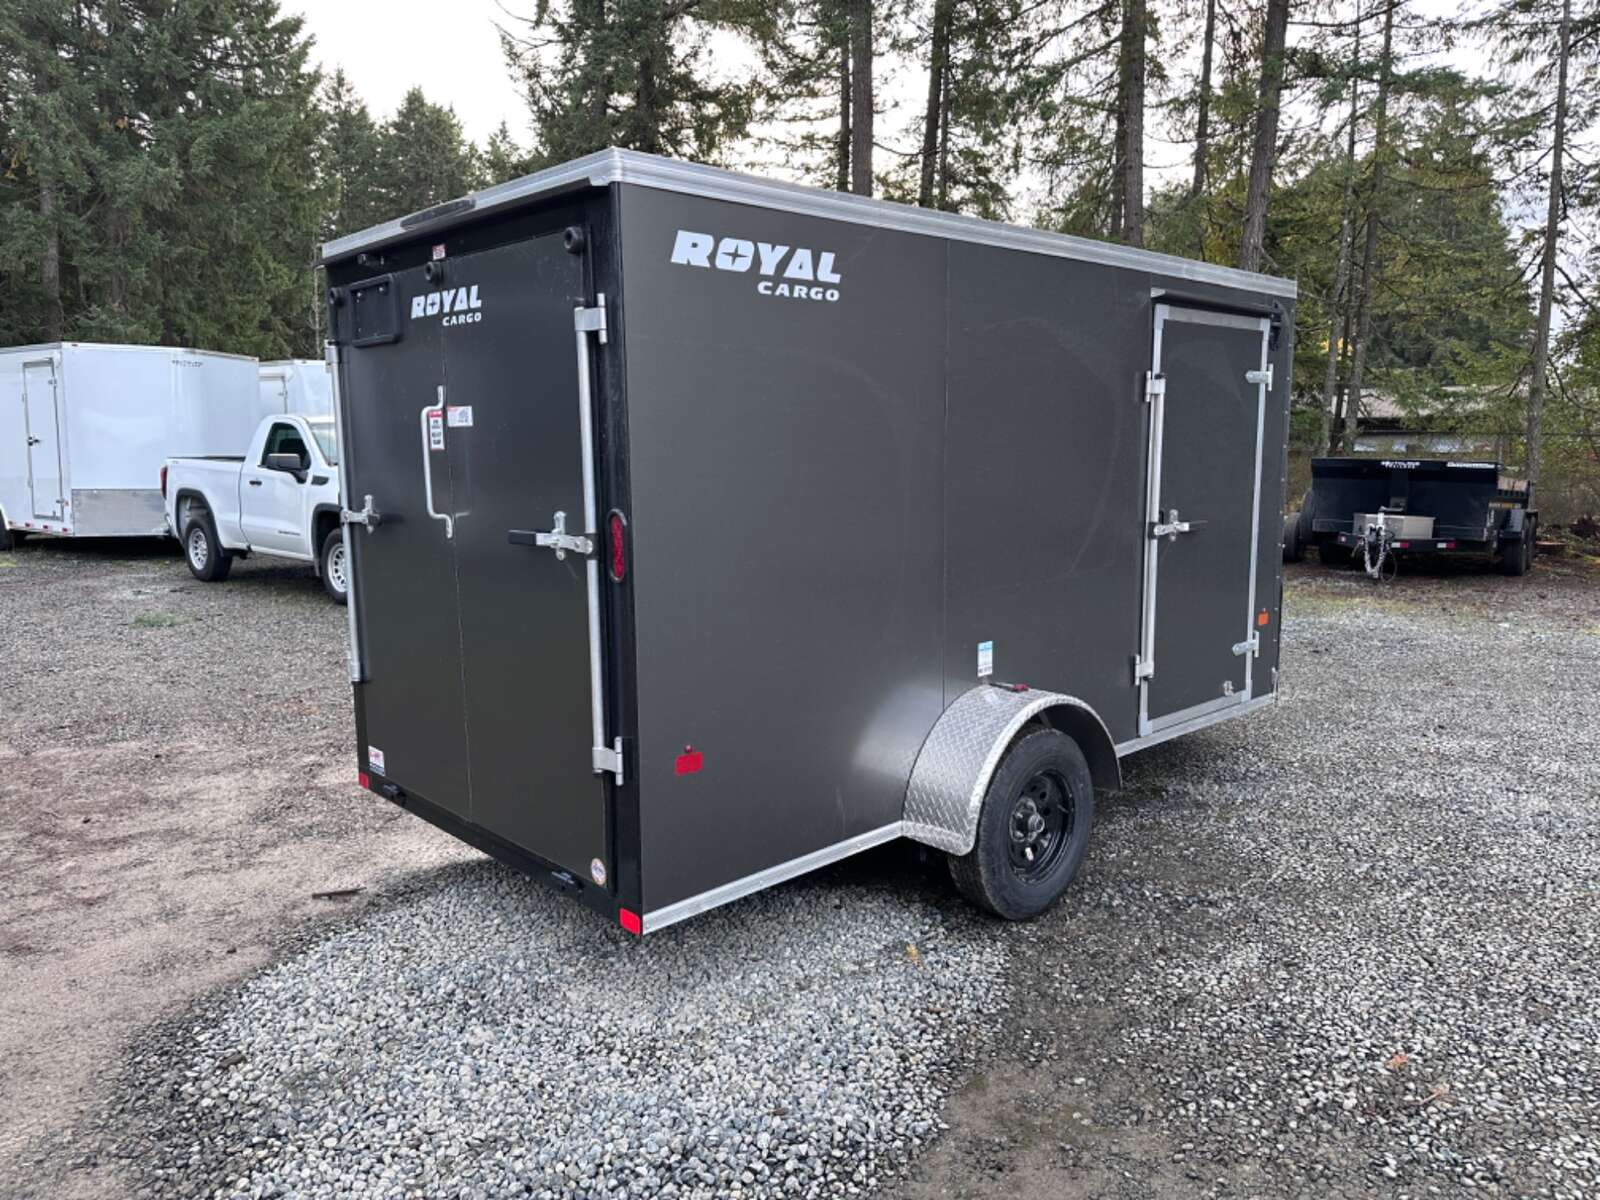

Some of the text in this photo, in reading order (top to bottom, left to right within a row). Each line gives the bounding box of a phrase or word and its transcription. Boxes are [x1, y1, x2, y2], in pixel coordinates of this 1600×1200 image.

[671, 230, 841, 284] ROYAL
[411, 284, 482, 319] ROYAL
[757, 281, 840, 301] CARGO
[442, 312, 482, 326] CARGO
